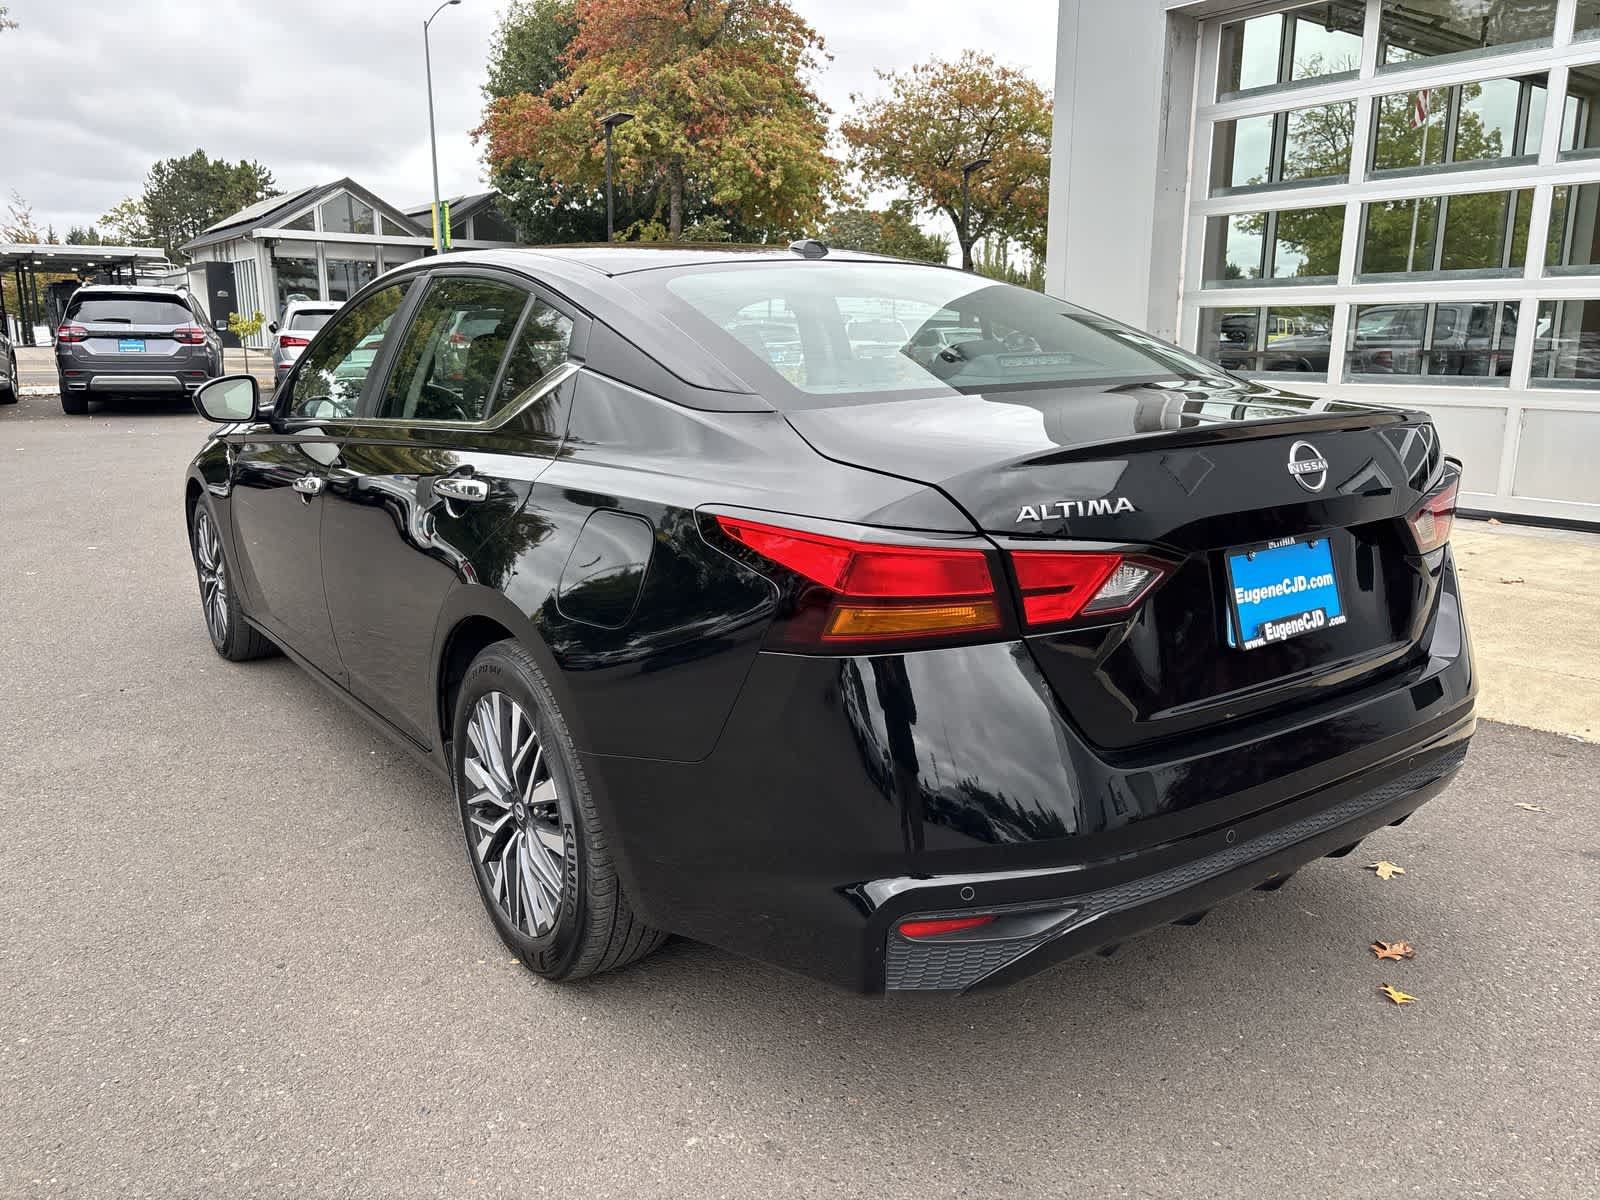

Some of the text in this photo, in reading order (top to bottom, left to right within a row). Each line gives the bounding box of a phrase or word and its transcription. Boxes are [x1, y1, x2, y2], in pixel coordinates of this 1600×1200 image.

[1288, 458, 1328, 474] NISSAN
[1016, 497, 1136, 522] ALTIMA
[1234, 573, 1334, 604] EugeneCJD.com
[1264, 609, 1325, 641] EugeneCJD
[564, 823, 577, 918] KUMHO
